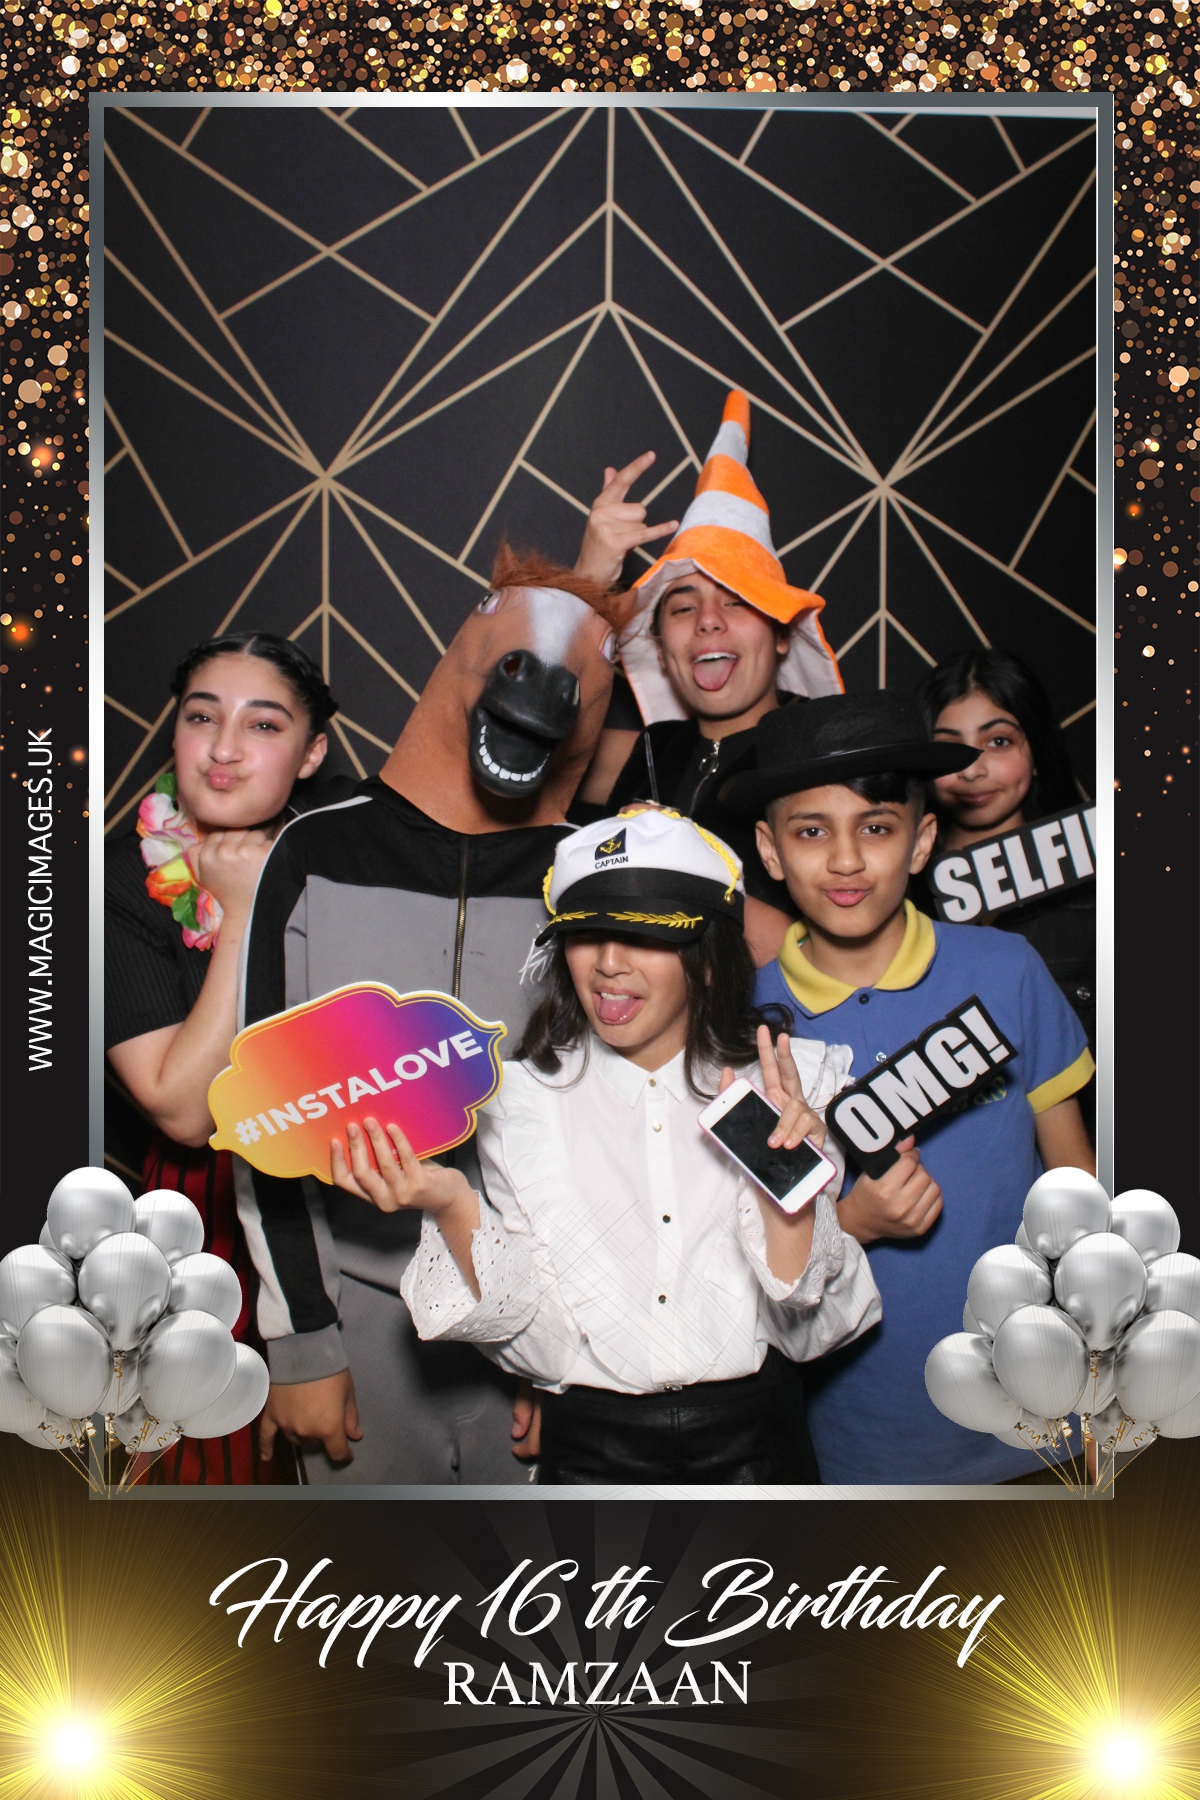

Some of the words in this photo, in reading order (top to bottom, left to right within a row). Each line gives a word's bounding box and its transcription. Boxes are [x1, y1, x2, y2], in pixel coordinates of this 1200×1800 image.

[595, 856, 629, 869] CAPTAIN
[234, 1030, 484, 1146] #INSTALOVE
[834, 1005, 1010, 1153] OMG!
